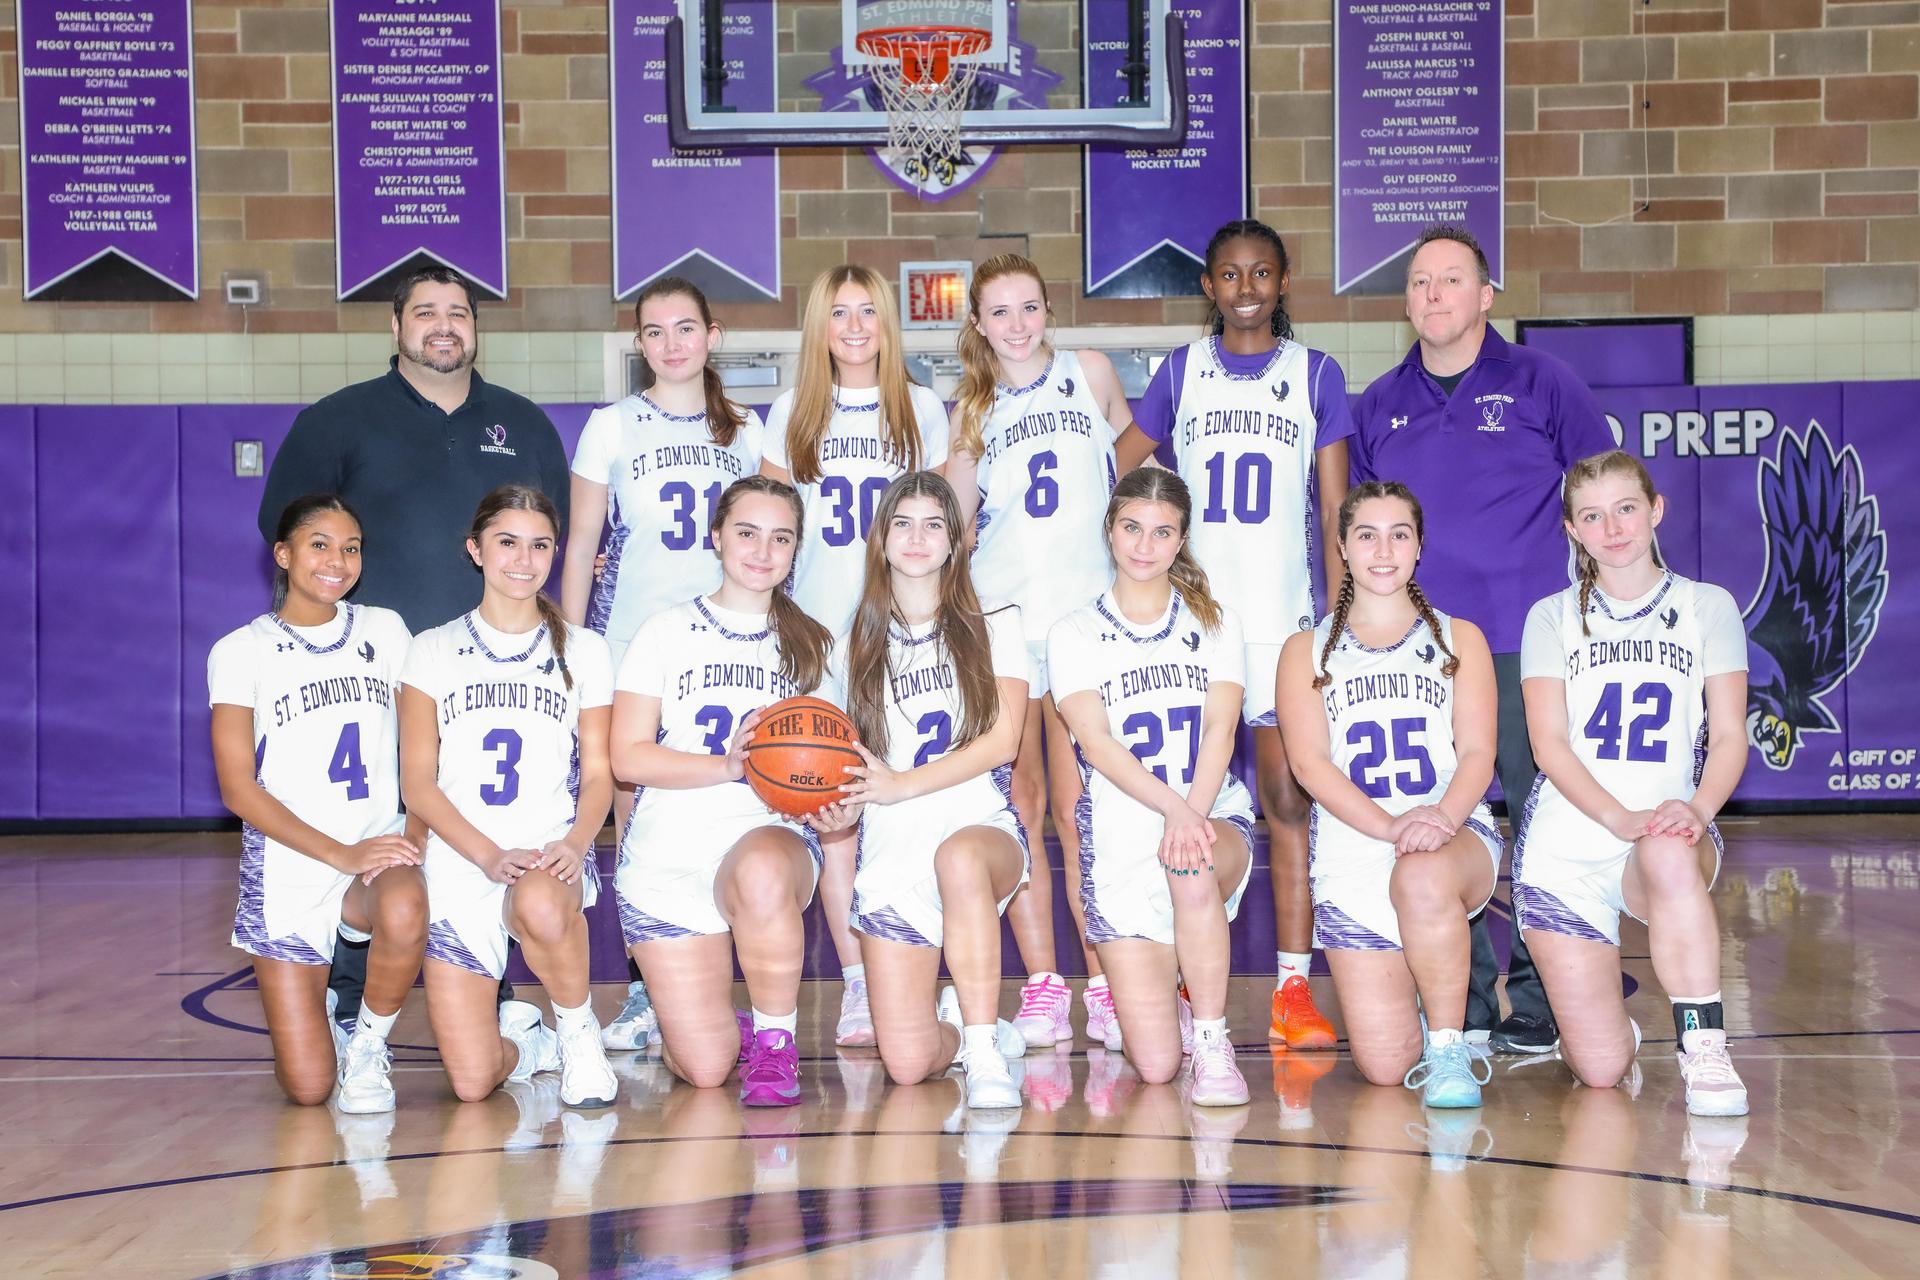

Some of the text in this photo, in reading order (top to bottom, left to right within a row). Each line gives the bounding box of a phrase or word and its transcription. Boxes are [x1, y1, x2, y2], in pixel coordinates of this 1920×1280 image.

[888, 0, 960, 13] EDMUND
[1350, 5, 1378, 14] DIANE
[56, 12, 135, 21] DANIEL BORGIA
[359, 13, 471, 22] MARYANNE MARSHALL
[886, 12, 982, 26] ATHLETIC
[1363, 13, 1477, 24] VOLLEYBALL BASKETBALL
[59, 23, 151, 32] BASEBALL HOCKEY
[379, 27, 434, 36] MARSAGGI
[420, 38, 469, 46] BASKETBALL
[1375, 32, 1447, 42] JOSEPH BURKE
[36, 40, 155, 51] PEGGY GAFFNEY BOYLE
[1369, 42, 1472, 52] BASKETBALL BASEBALL
[80, 52, 131, 61] BASKETBALL
[400, 48, 441, 57] SOFTBALL
[1415, 59, 1457, 68] MARCUS
[24, 68, 170, 78] DANIELLE ESPOSITO GRAZIANO
[344, 65, 489, 74] SISTER DENISE OP
[372, 76, 462, 84] HONORARY MEMBER
[1382, 70, 1459, 80] TRACK AND FIELD
[85, 79, 128, 88] SOFTBALL
[1363, 87, 1459, 97] ANTHONY OGLESBY
[59, 96, 136, 106] MICHAEL IRWIN
[341, 93, 475, 103] JEANNE SULLIVAN TOOMEY
[1395, 99, 1445, 107] BASKETBALL
[82, 108, 133, 116] BASKETBALL
[370, 105, 466, 113] BASKETBALL COACH
[371, 121, 448, 130] ROBERT WIATRE
[1383, 116, 1457, 127] DANIEL WIATRE
[45, 124, 153, 134] DEBRA LETTS
[1361, 127, 1479, 138] COACH ADMINISTRATOR
[83, 135, 134, 145] BASKETBALL
[394, 132, 444, 140] BASKETBALL
[365, 147, 473, 156] CHRISTOPHER WRIGHT
[1157, 148, 1207, 157] 2007 BOYS
[1368, 145, 1472, 155] THE LOUISON FAMILY
[31, 154, 169, 165] KATHLEEN MURPHY MAGUIRE
[360, 158, 478, 167] COACH ADMINISTRATOR
[652, 158, 742, 167] BASKETBALL TEAM
[1132, 160, 1200, 169] HOCKEY TEAM
[84, 166, 135, 174] BASKETBALL
[433, 175, 461, 184] GIRLS
[1383, 174, 1457, 184] GUY DEFONZO
[65, 183, 154, 192] KATHLEEN VULPIS
[374, 186, 465, 196] BASKETBALL TEAM
[1387, 187, 1418, 195] AQUINAS
[49, 194, 170, 203] COACH ADMINISTRATOR
[395, 204, 447, 213] 1997 BOYS
[1372, 201, 1468, 211] 2003 BOYS VARSITY
[124, 211, 152, 220] GIRLS
[382, 215, 459, 224] BASEBALL TEAM
[1376, 212, 1464, 222] BASKETBALL TEAM
[64, 221, 157, 231] VOLLEYBALL TEAM
[908, 273, 957, 321] EXIT
[1005, 412, 1056, 448] EDMUND
[1061, 410, 1091, 439] PREP
[1185, 409, 1299, 448] ST. EDMUND PREP
[1641, 409, 1775, 457] PREP
[822, 437, 877, 462] EDMUND
[632, 445, 742, 481] ST. EDMUND PREP
[1025, 450, 1059, 518] 6
[1204, 451, 1272, 524] 10
[659, 481, 723, 550] 31
[1568, 640, 1693, 680] ST. EDMUND PREP
[678, 664, 764, 700] ST. EDMUND
[893, 663, 953, 704] EDMUND
[1123, 663, 1182, 699] EDMUND
[275, 677, 361, 727] ST. EDMUND
[1325, 673, 1446, 721] ST. EDMUND PREP
[443, 683, 568, 724] ST. EDMUND PREP
[768, 713, 850, 742] THE ROCK
[1584, 682, 1672, 763] 42
[1122, 705, 1201, 784] 27
[328, 722, 369, 801] 4
[1346, 717, 1437, 798] 25
[1830, 749, 1915, 768] A GIFT OF
[480, 728, 522, 806] 3
[790, 774, 825, 786] ROCK
[1828, 775, 1880, 791] CLASS
[1885, 774, 1911, 790] OF
